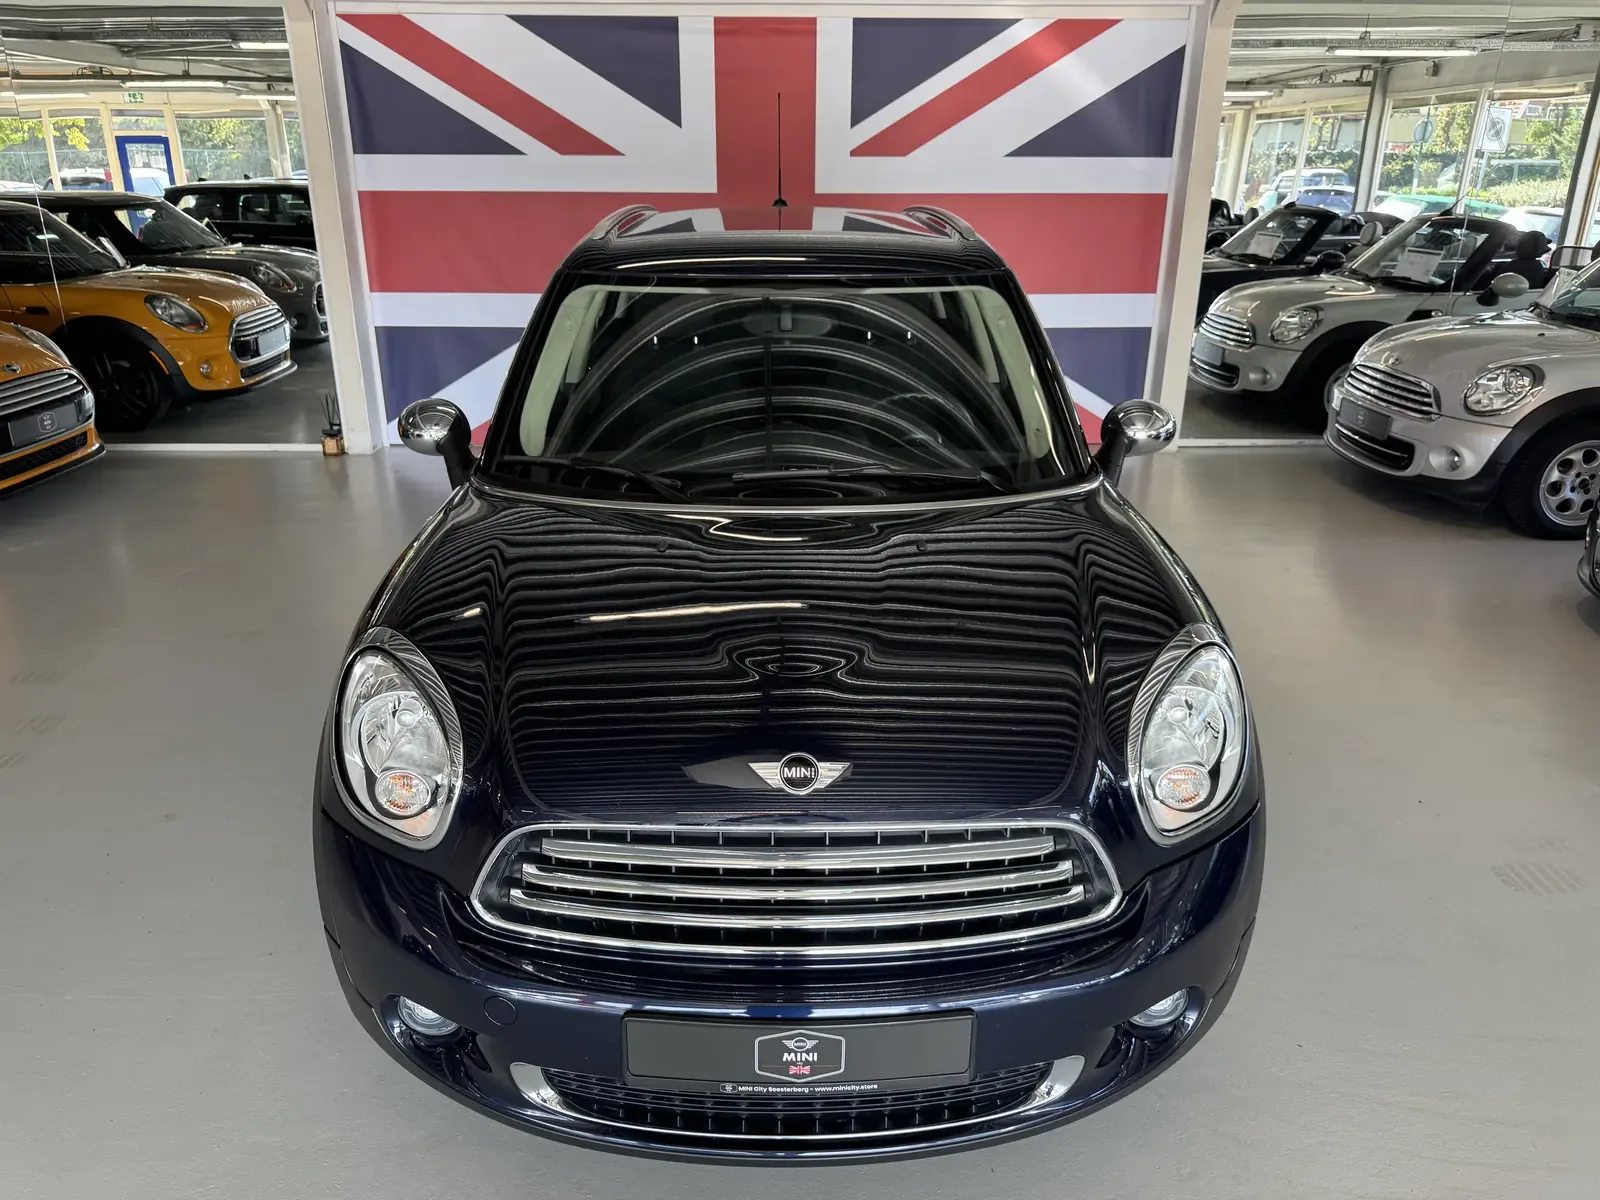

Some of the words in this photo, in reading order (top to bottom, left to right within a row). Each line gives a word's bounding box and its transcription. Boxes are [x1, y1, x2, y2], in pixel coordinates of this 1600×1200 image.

[783, 766, 815, 778] MINI
[782, 1052, 818, 1062] MINI
[754, 1085, 767, 1093] City
[814, 1084, 878, 1092] www.minicity.store
